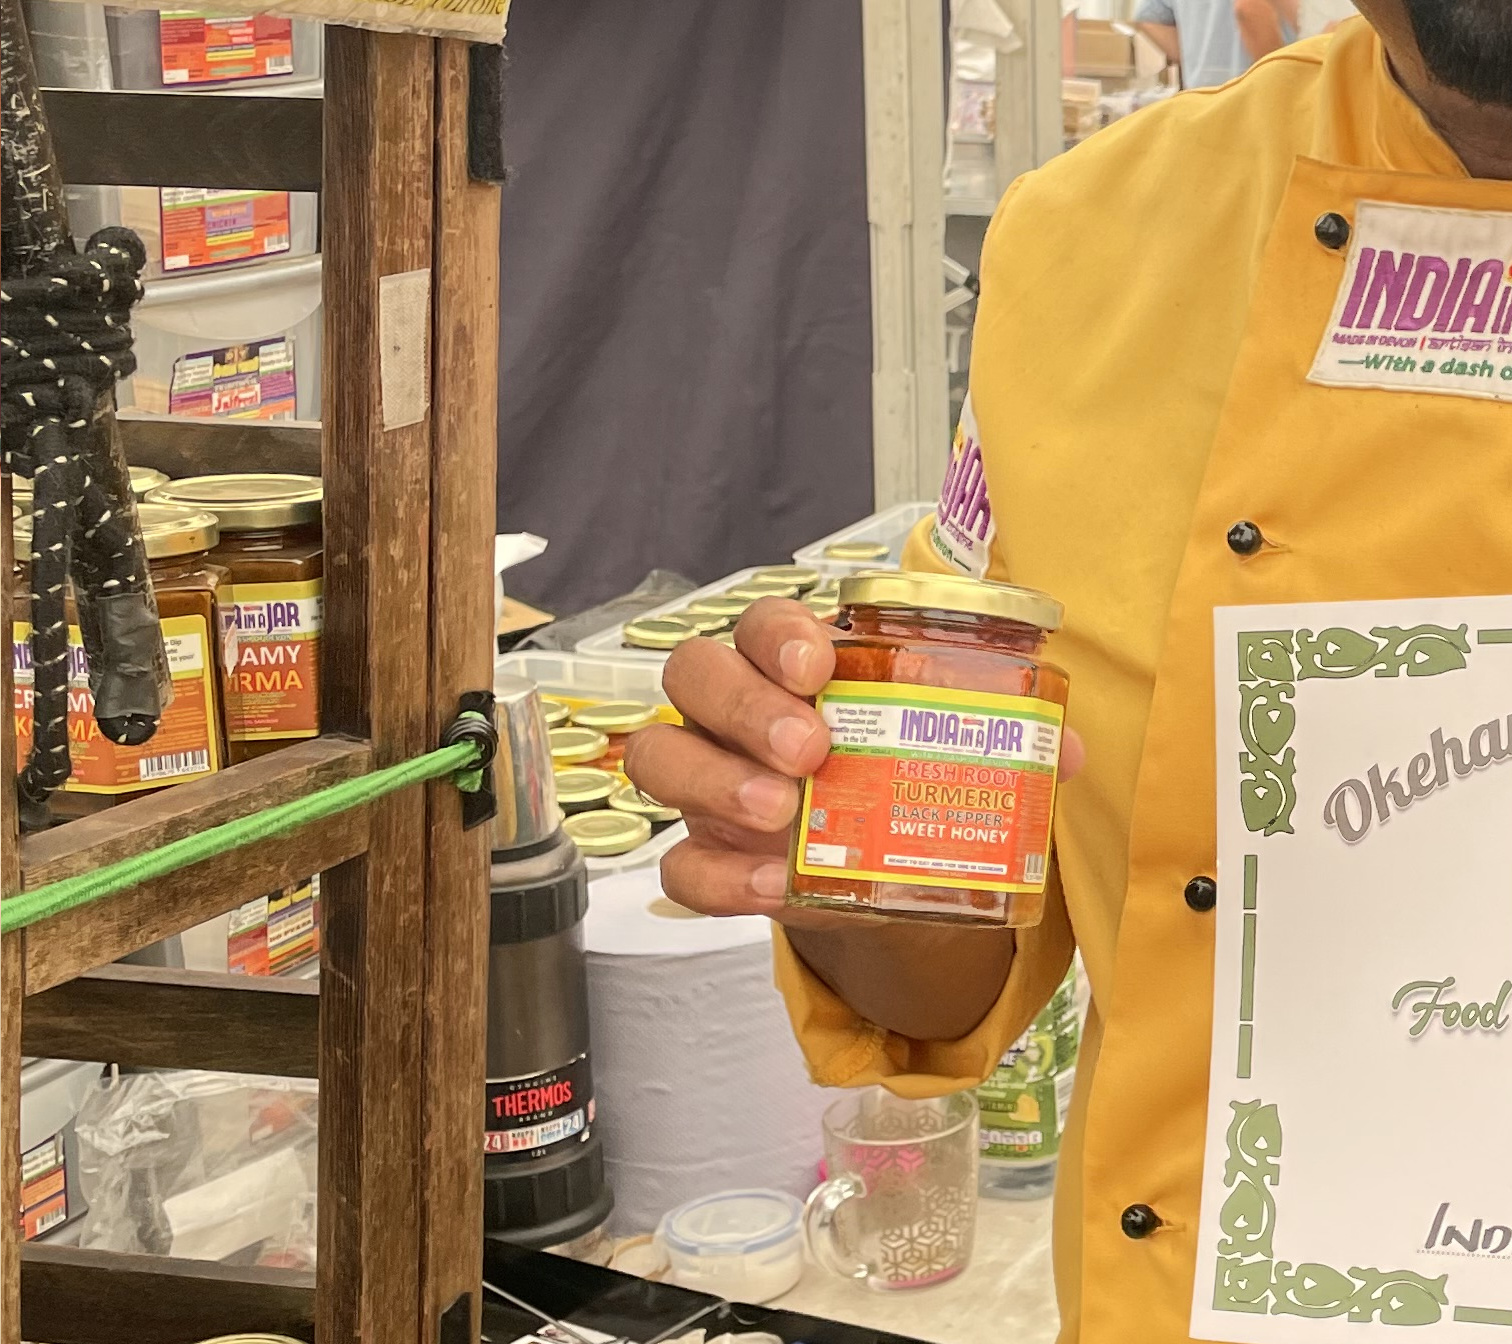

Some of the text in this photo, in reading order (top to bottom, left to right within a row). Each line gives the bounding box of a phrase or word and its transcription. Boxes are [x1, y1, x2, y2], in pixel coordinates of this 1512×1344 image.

[1339, 247, 1504, 334] INDIA
[1362, 353, 1415, 374] With
[1420, 360, 1434, 374] a
[1439, 356, 1493, 378] dash
[267, 602, 300, 633] JAR
[899, 709, 1024, 756] INDIA JAR
[894, 759, 1020, 788] FRESH ROOT
[892, 781, 1015, 810] TURMERIC
[891, 805, 1003, 827] BLACK PEPPER
[889, 821, 1009, 844] SWEET HONEY
[1392, 977, 1512, 1038] Food
[492, 1080, 574, 1118] THERMOS
